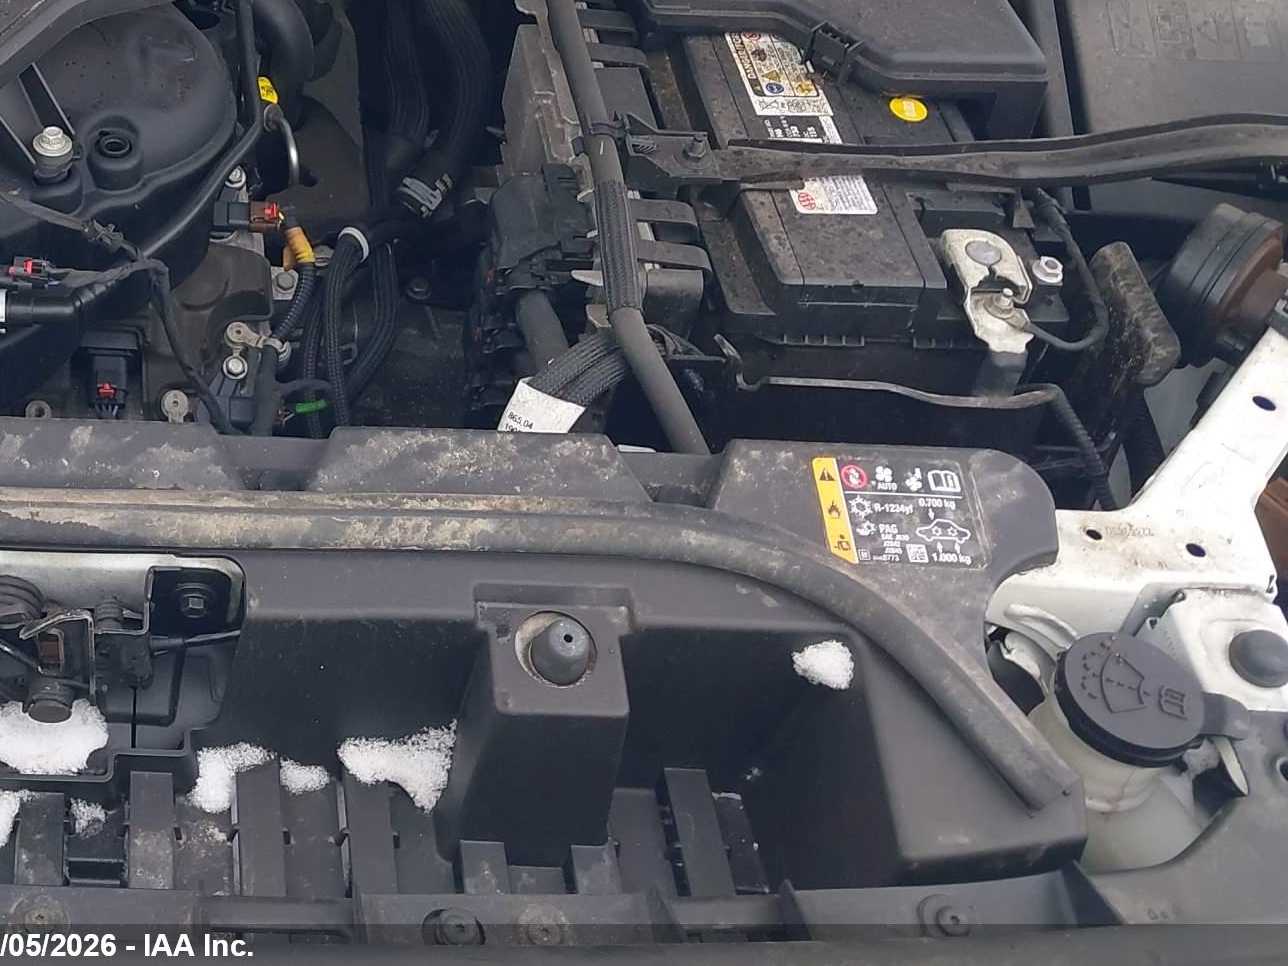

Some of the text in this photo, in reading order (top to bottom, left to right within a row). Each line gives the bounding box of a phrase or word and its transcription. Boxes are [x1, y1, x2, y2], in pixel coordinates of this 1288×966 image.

[877, 482, 897, 491] AUTO
[918, 498, 956, 510] 0.700 kg
[878, 524, 899, 534] PAG
[932, 553, 972, 565] 1.000 kg
